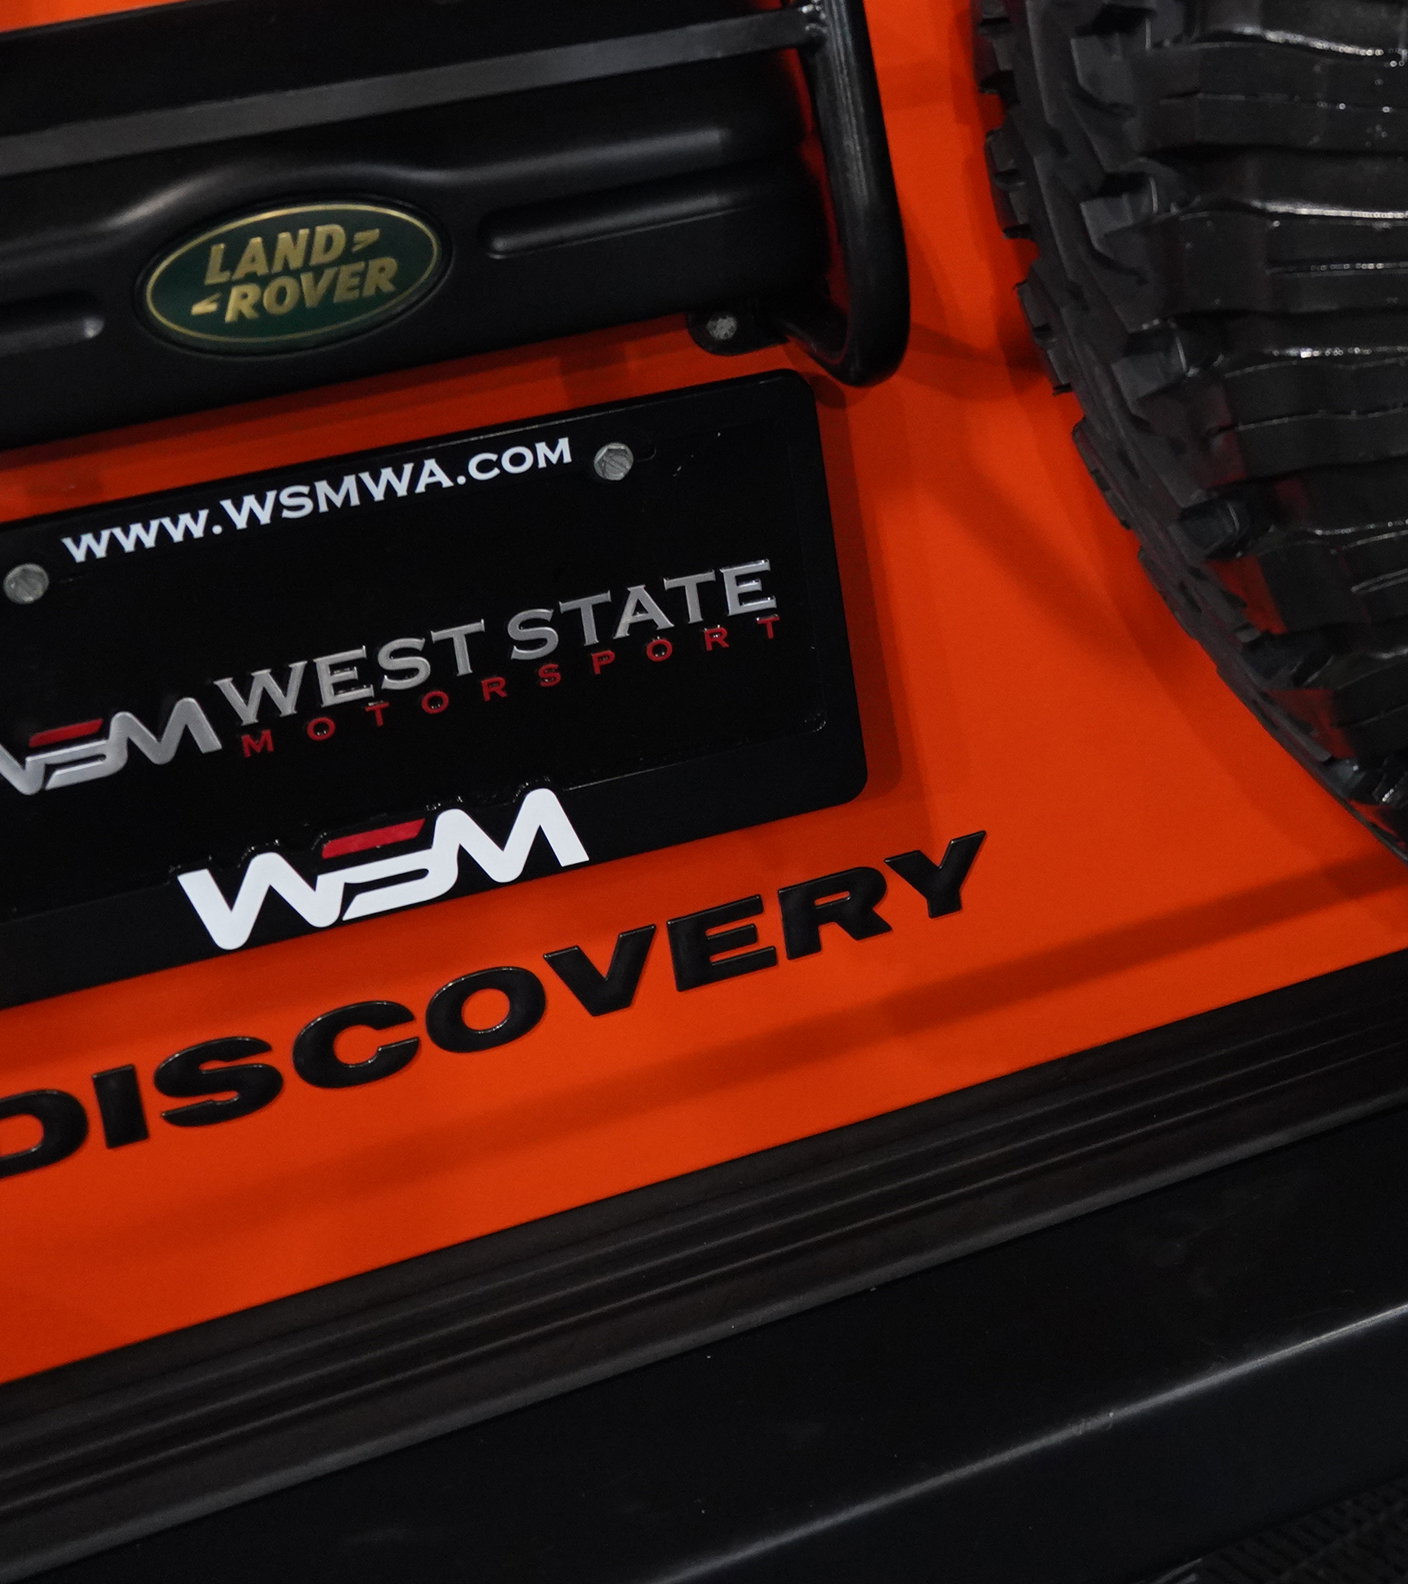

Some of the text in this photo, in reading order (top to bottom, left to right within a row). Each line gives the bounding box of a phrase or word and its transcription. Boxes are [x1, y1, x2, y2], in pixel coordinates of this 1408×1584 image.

[61, 436, 573, 565] WWW.WSMWA.COM
[212, 558, 779, 726] WEST STATE
[241, 616, 780, 759] MOTORSPORT
[0, 829, 987, 1182] DISCOVERY
